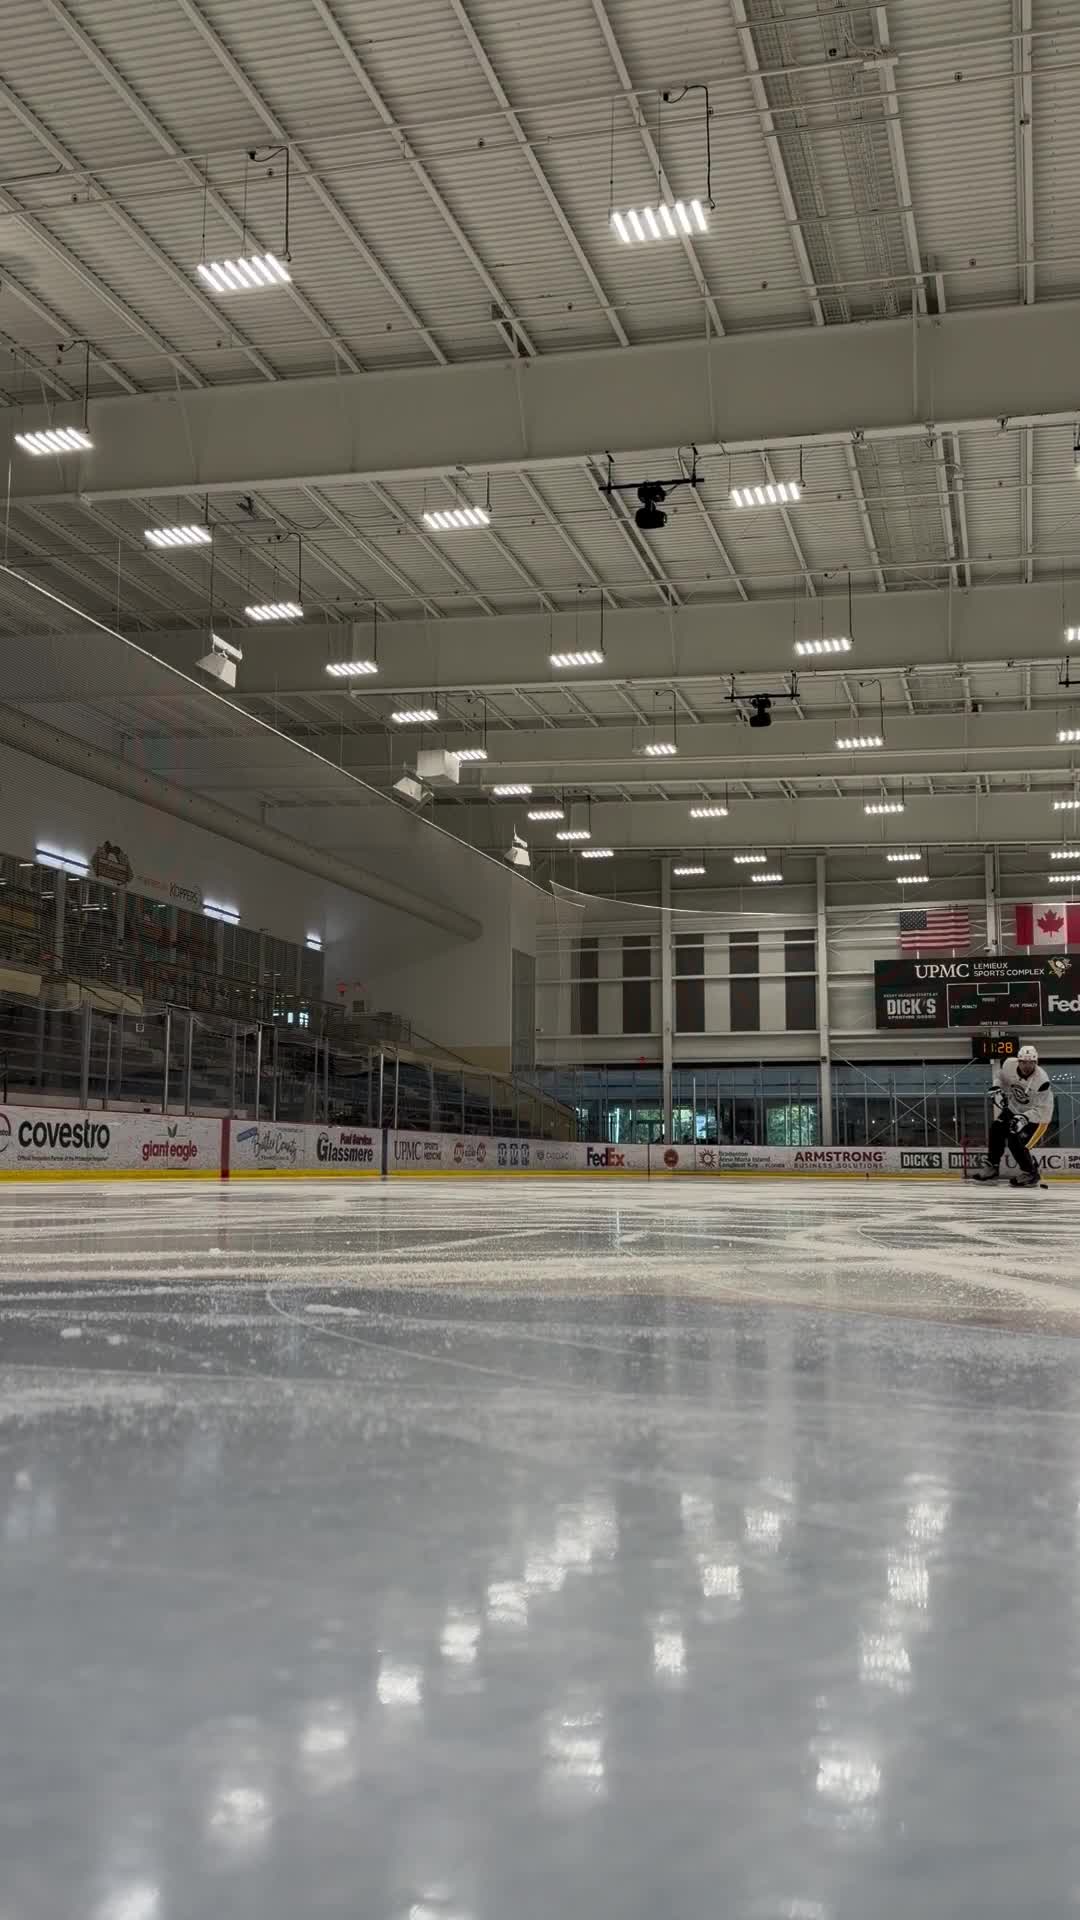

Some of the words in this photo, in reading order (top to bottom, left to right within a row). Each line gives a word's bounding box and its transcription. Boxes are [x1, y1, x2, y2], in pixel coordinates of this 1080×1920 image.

[915, 963, 969, 978] UPMC
[974, 962, 1008, 970] LEMIEUX
[1006, 968, 1045, 976] COMPLEX
[887, 998, 936, 1015] DICK'S
[983, 1042, 1013, 1053] 11:28
[18, 1119, 110, 1149] covestro
[142, 1140, 169, 1161] giant
[170, 1140, 198, 1161] eagle
[316, 1132, 374, 1162] Glassmere
[394, 1140, 422, 1161] UPMC
[586, 1146, 625, 1167] FedEx
[795, 1151, 883, 1162] ARMSTRONG
[902, 1154, 940, 1167] DICK'S
